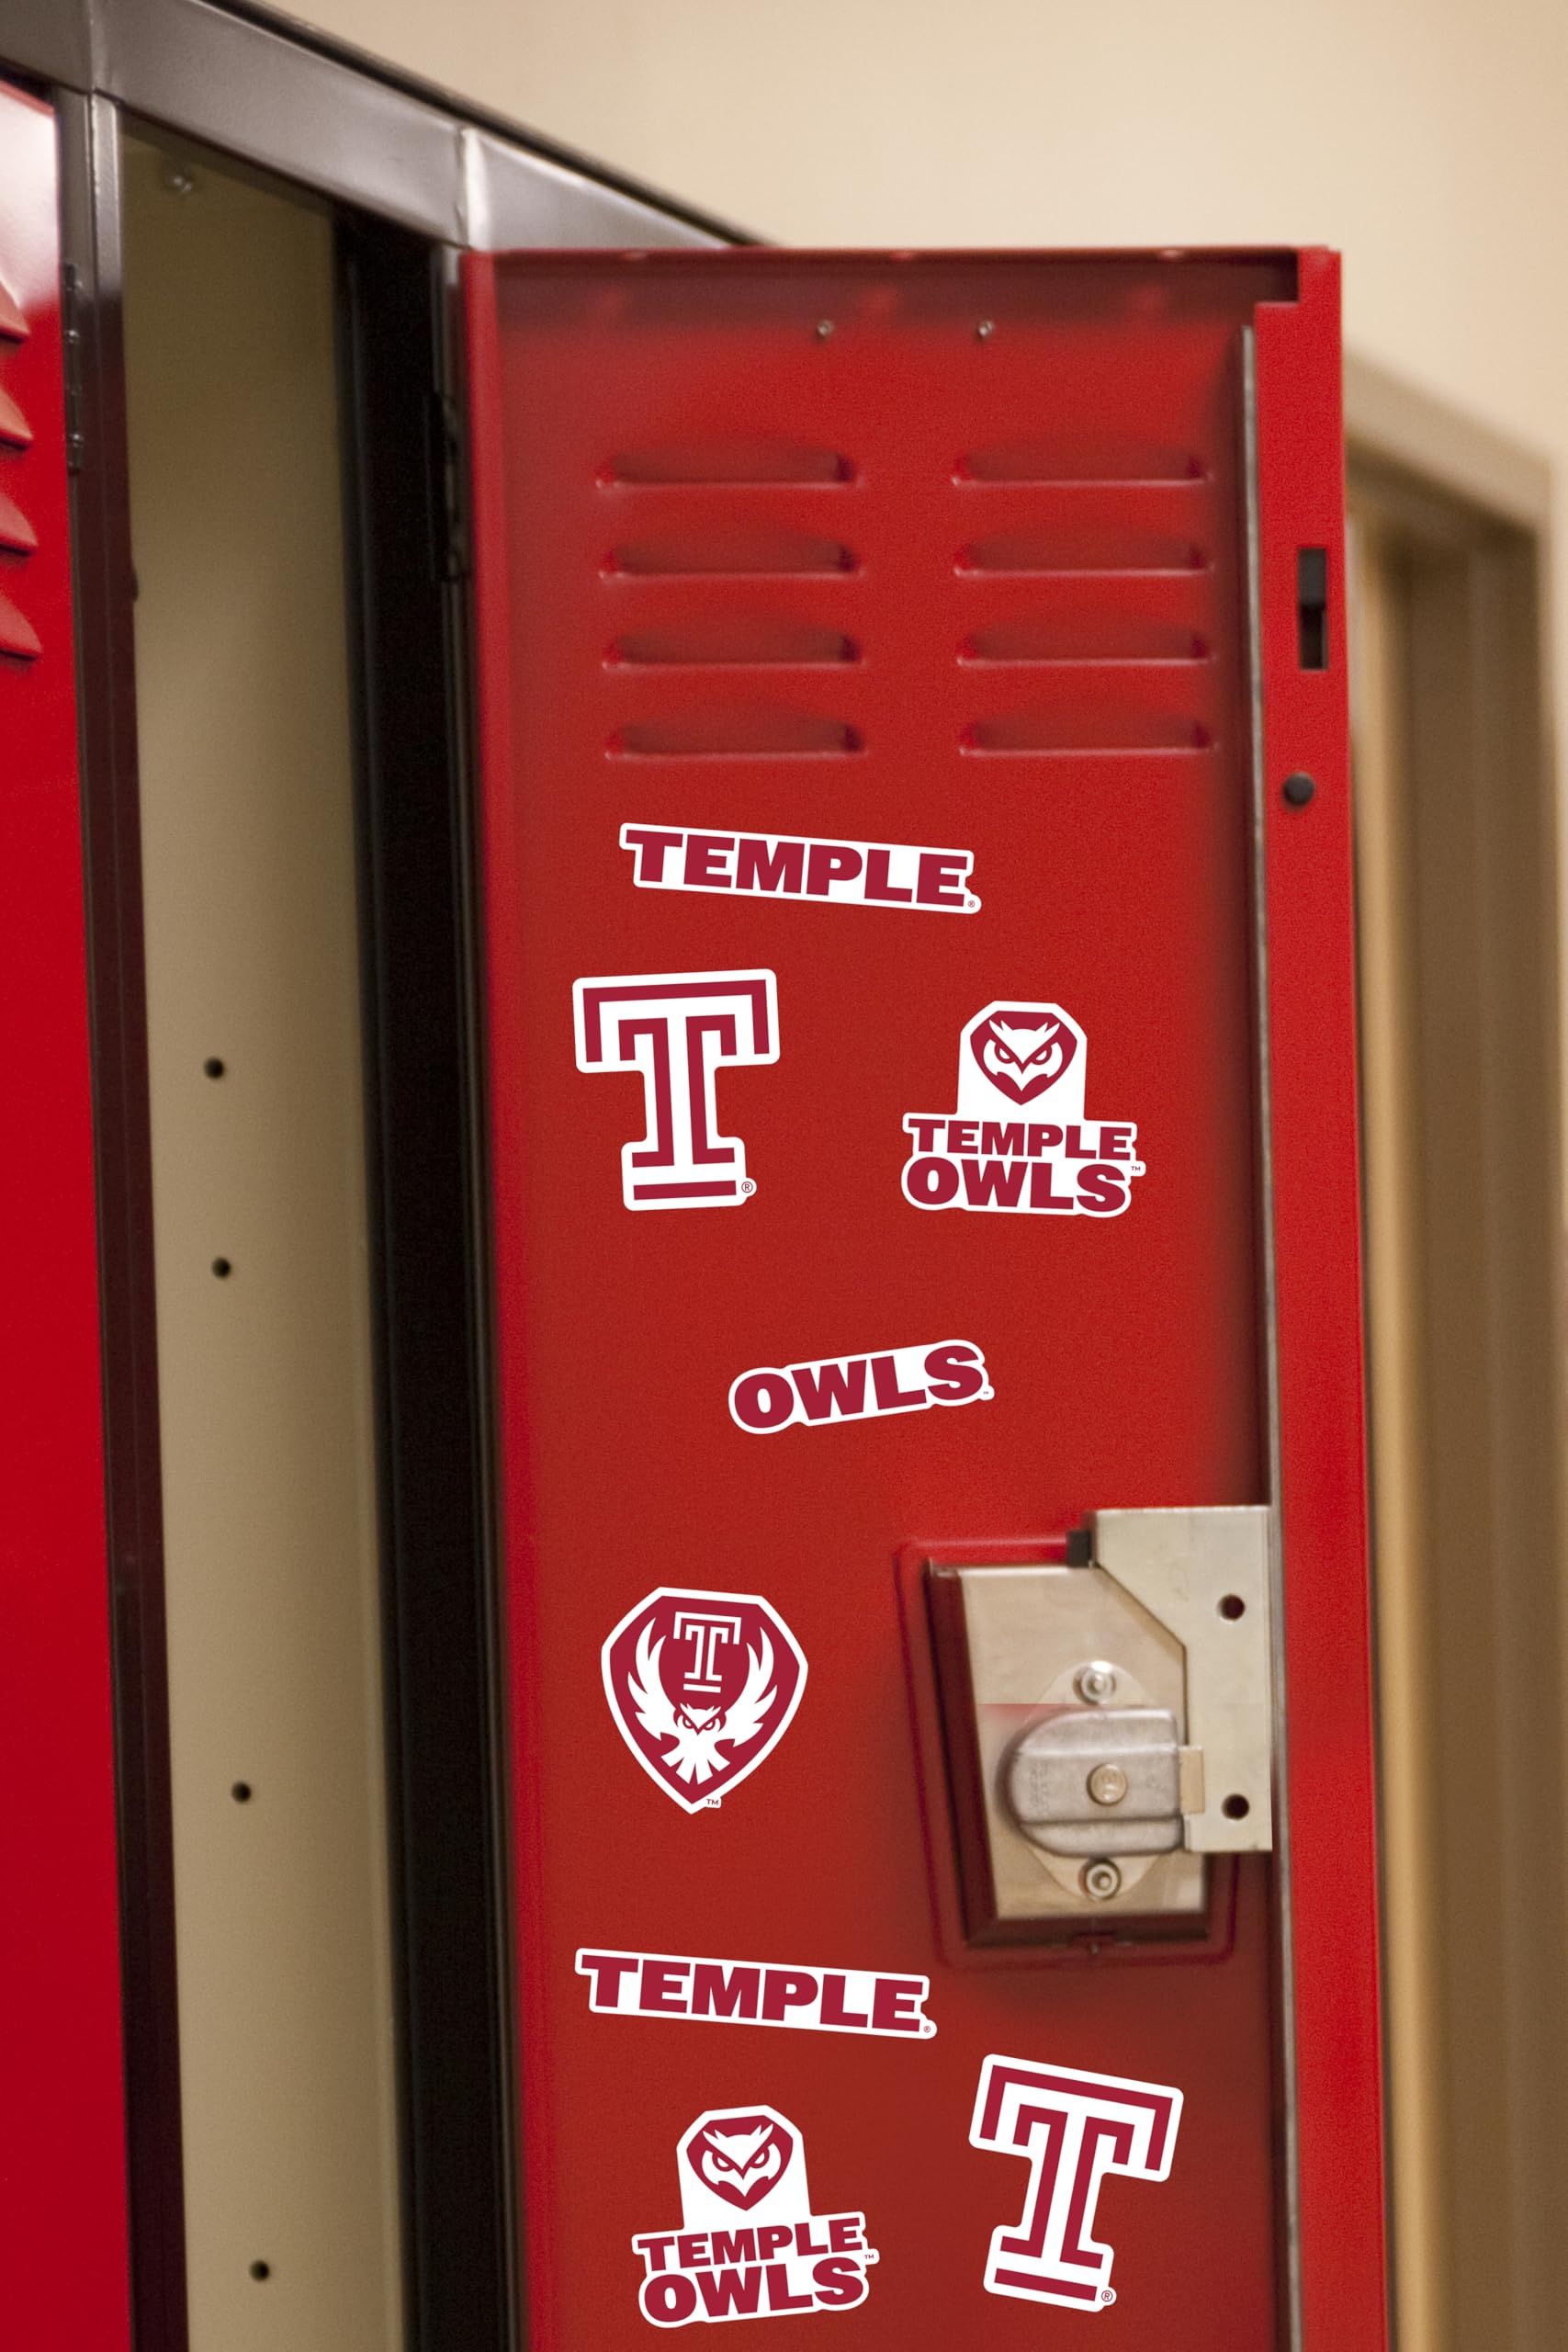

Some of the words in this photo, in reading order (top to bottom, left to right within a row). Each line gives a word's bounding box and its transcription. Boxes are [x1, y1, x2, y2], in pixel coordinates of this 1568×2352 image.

[626, 829, 967, 907] TEMPLE
[582, 978, 771, 1201] T
[908, 1118, 1132, 1160] TEMPLE
[907, 1157, 1125, 1212] OWLS
[734, 1345, 984, 1429] OWLS
[672, 1611, 742, 1693] T
[581, 1954, 923, 2031] TEMPLE
[980, 2064, 1174, 2301] T
[637, 2217, 863, 2271] TEMPLE
[644, 2257, 863, 2323] OWLS
